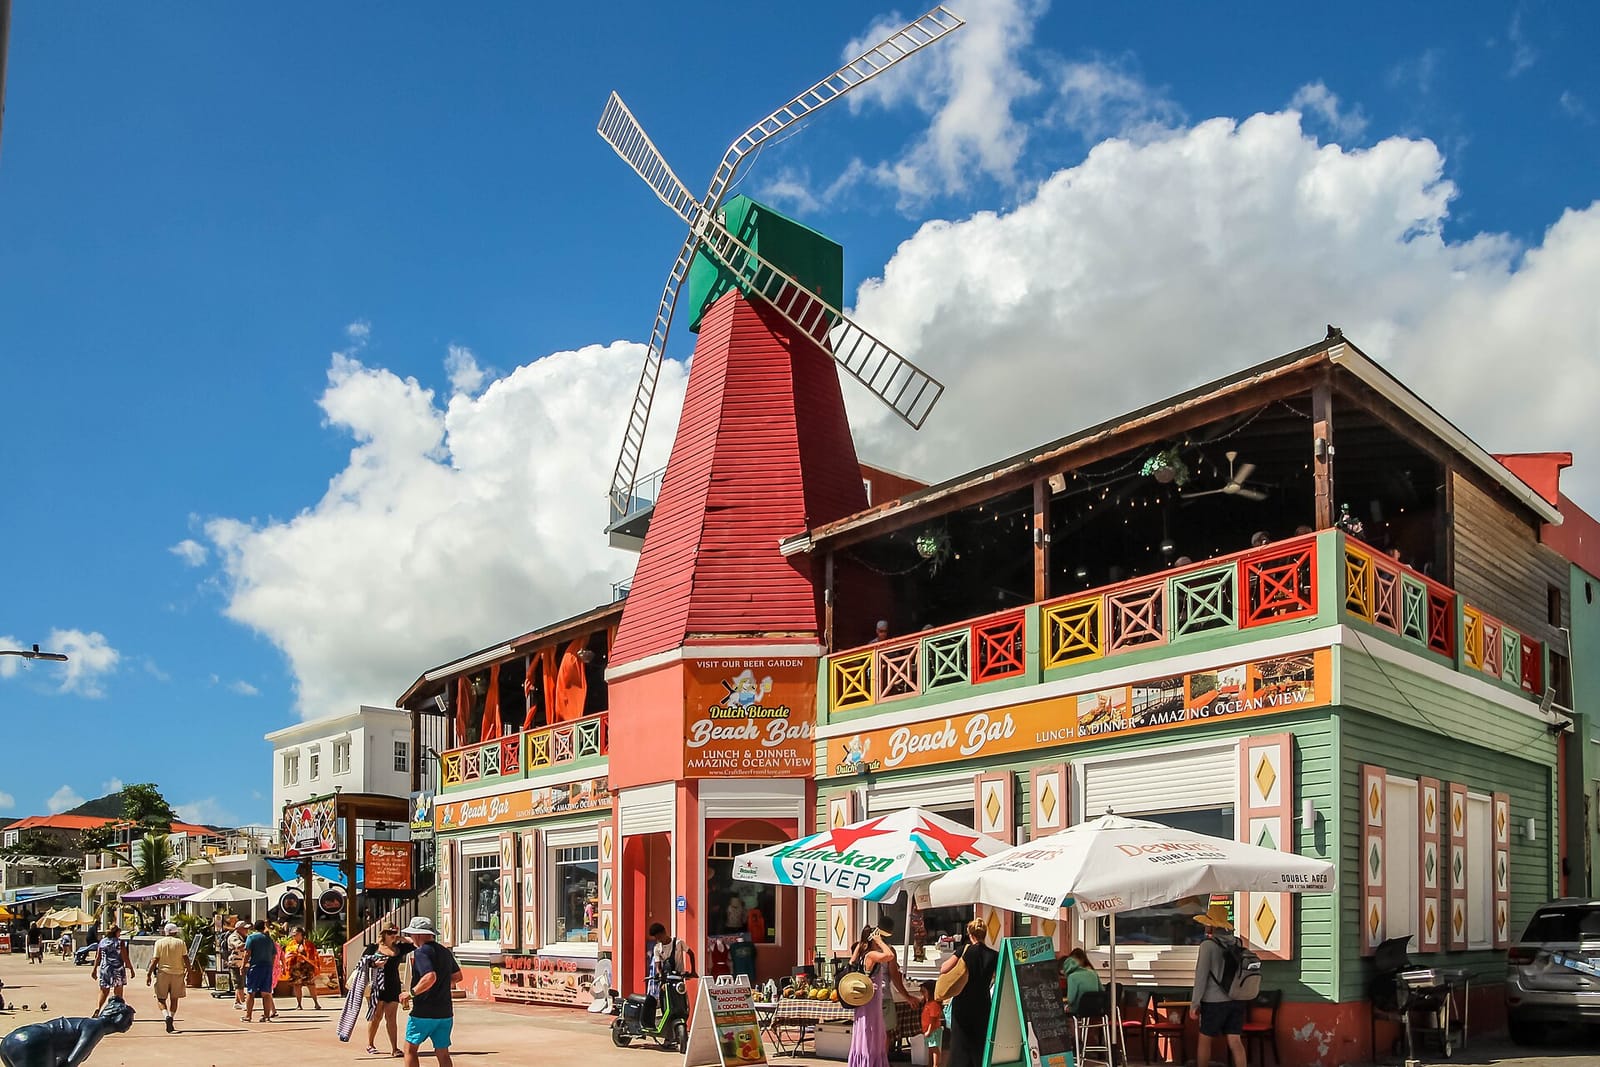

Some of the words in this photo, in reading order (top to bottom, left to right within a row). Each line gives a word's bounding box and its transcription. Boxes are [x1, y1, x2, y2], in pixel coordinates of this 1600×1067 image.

[696, 661, 719, 669] VISIT
[722, 660, 741, 668] OUR
[743, 660, 765, 668] BEER
[708, 704, 744, 719] Dutch
[746, 704, 790, 719] Blonde
[1036, 727, 1075, 743] LUNCH
[1078, 724, 1088, 737] &
[1090, 716, 1137, 736] DINNER
[1148, 705, 1211, 726] AMAZING
[1214, 697, 1264, 715] OCEAN
[1267, 690, 1308, 707] VIEW
[686, 719, 760, 748] Beach
[761, 718, 813, 747] Bar
[884, 719, 959, 767] Beach
[959, 712, 1017, 757] Bar
[703, 750, 740, 759] LUNCH
[743, 750, 752, 759] &
[756, 749, 797, 758] DINNER
[687, 759, 738, 768] AMAZING
[742, 759, 780, 768] OCEAN
[784, 759, 813, 767] VIEW
[459, 801, 488, 826] Beach
[487, 796, 509, 822] Bar
[1114, 840, 1219, 858] Dewar's
[1148, 851, 1195, 863] DOUBLE
[765, 845, 895, 873] Heineken
[791, 861, 872, 894] SILVER
[1281, 874, 1309, 883] DOUBLE
[1311, 874, 1328, 883] AGED
[1023, 892, 1043, 903] DOUBLE
[1042, 896, 1056, 906] AGED
[1080, 896, 1122, 913] Dewar's
